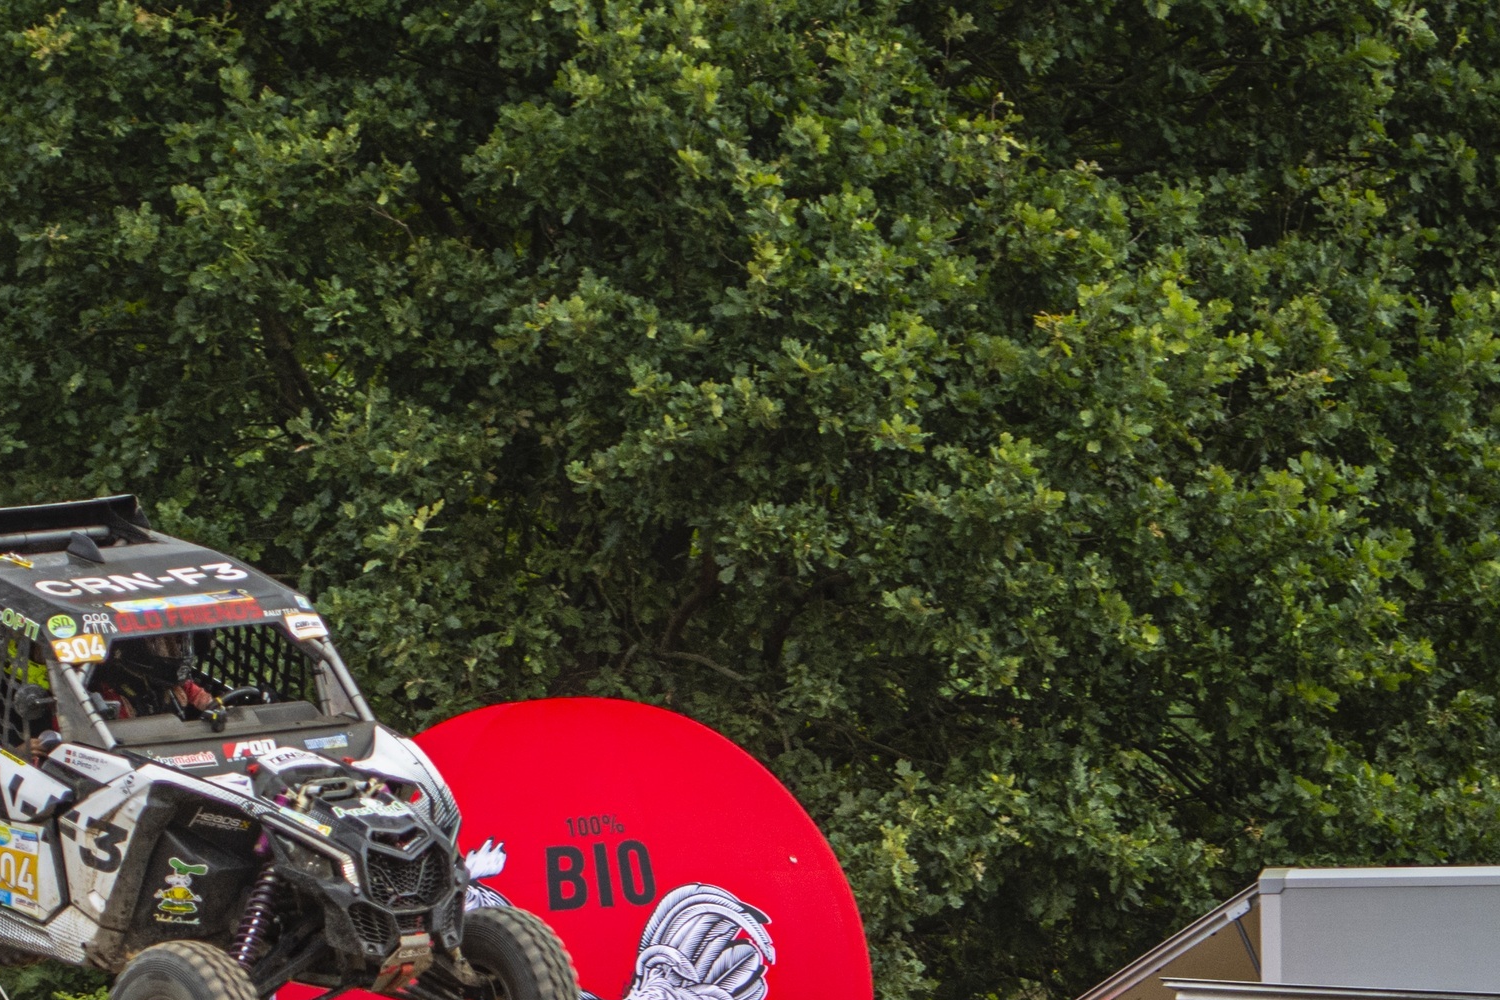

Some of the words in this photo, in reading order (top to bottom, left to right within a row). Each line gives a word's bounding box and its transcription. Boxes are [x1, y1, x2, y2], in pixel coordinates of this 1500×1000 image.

[35, 562, 248, 596] CRN-F3
[114, 611, 163, 633] OLD
[165, 599, 265, 628] FRIENDS
[55, 635, 106, 662] 304
[565, 815, 625, 836] 100%
[545, 839, 656, 911] BIO
